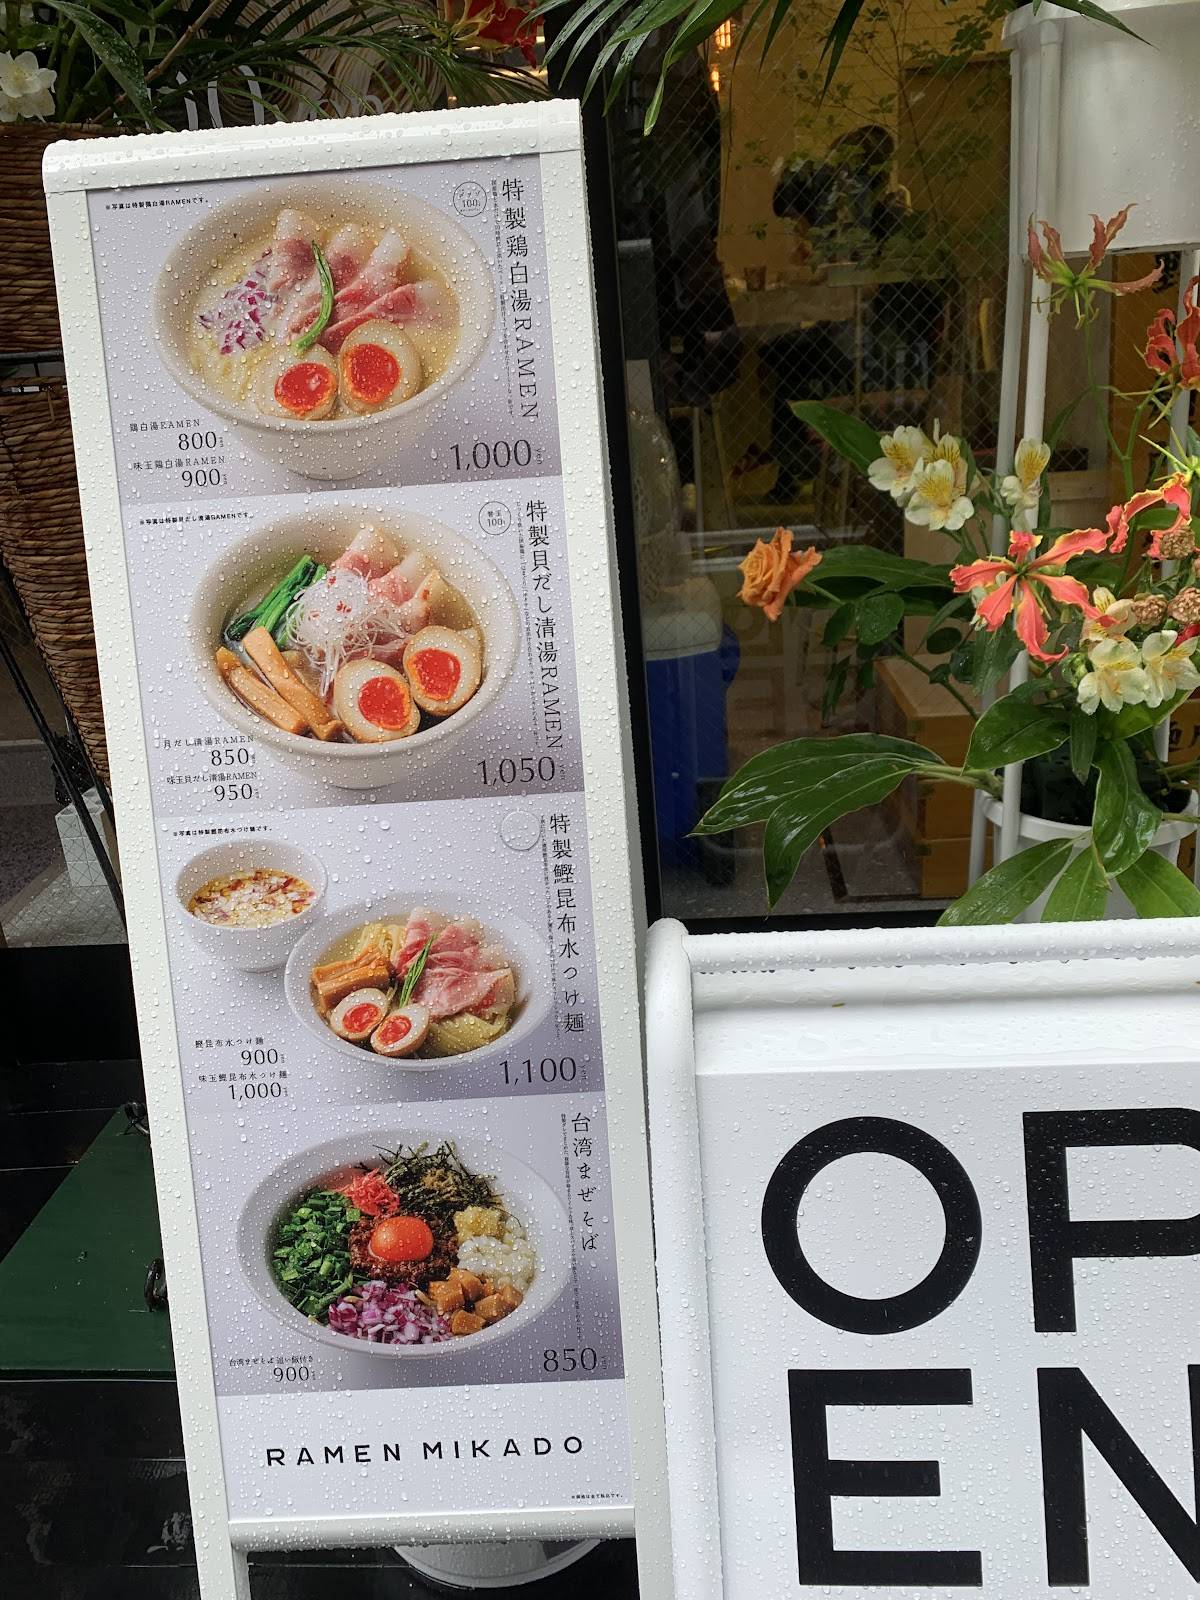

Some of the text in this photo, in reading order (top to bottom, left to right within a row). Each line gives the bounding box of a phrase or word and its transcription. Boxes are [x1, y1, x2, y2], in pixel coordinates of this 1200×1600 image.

[502, 178, 539, 418] 特製鶏白湯RAMEN
[178, 431, 217, 450] 800
[449, 439, 532, 471] 1,000
[181, 468, 221, 488] 900
[526, 499, 564, 750] 特製貝だし清湯RAMEN
[211, 747, 249, 767] 850
[477, 756, 556, 786] 1,050
[214, 783, 253, 802] 950
[549, 813, 585, 1034] 特製鰹昆布水つけ麺
[241, 1048, 278, 1066] 900
[499, 1056, 577, 1086] 1,100
[228, 1082, 282, 1101] 1,000
[571, 1112, 599, 1251] 台湾まぜそば
[761, 1107, 1200, 1336] OP
[273, 1366, 309, 1383] 900
[543, 1347, 598, 1372] 850
[266, 1436, 584, 1467] RAMEN MIKADO
[787, 1364, 1200, 1588] EN
